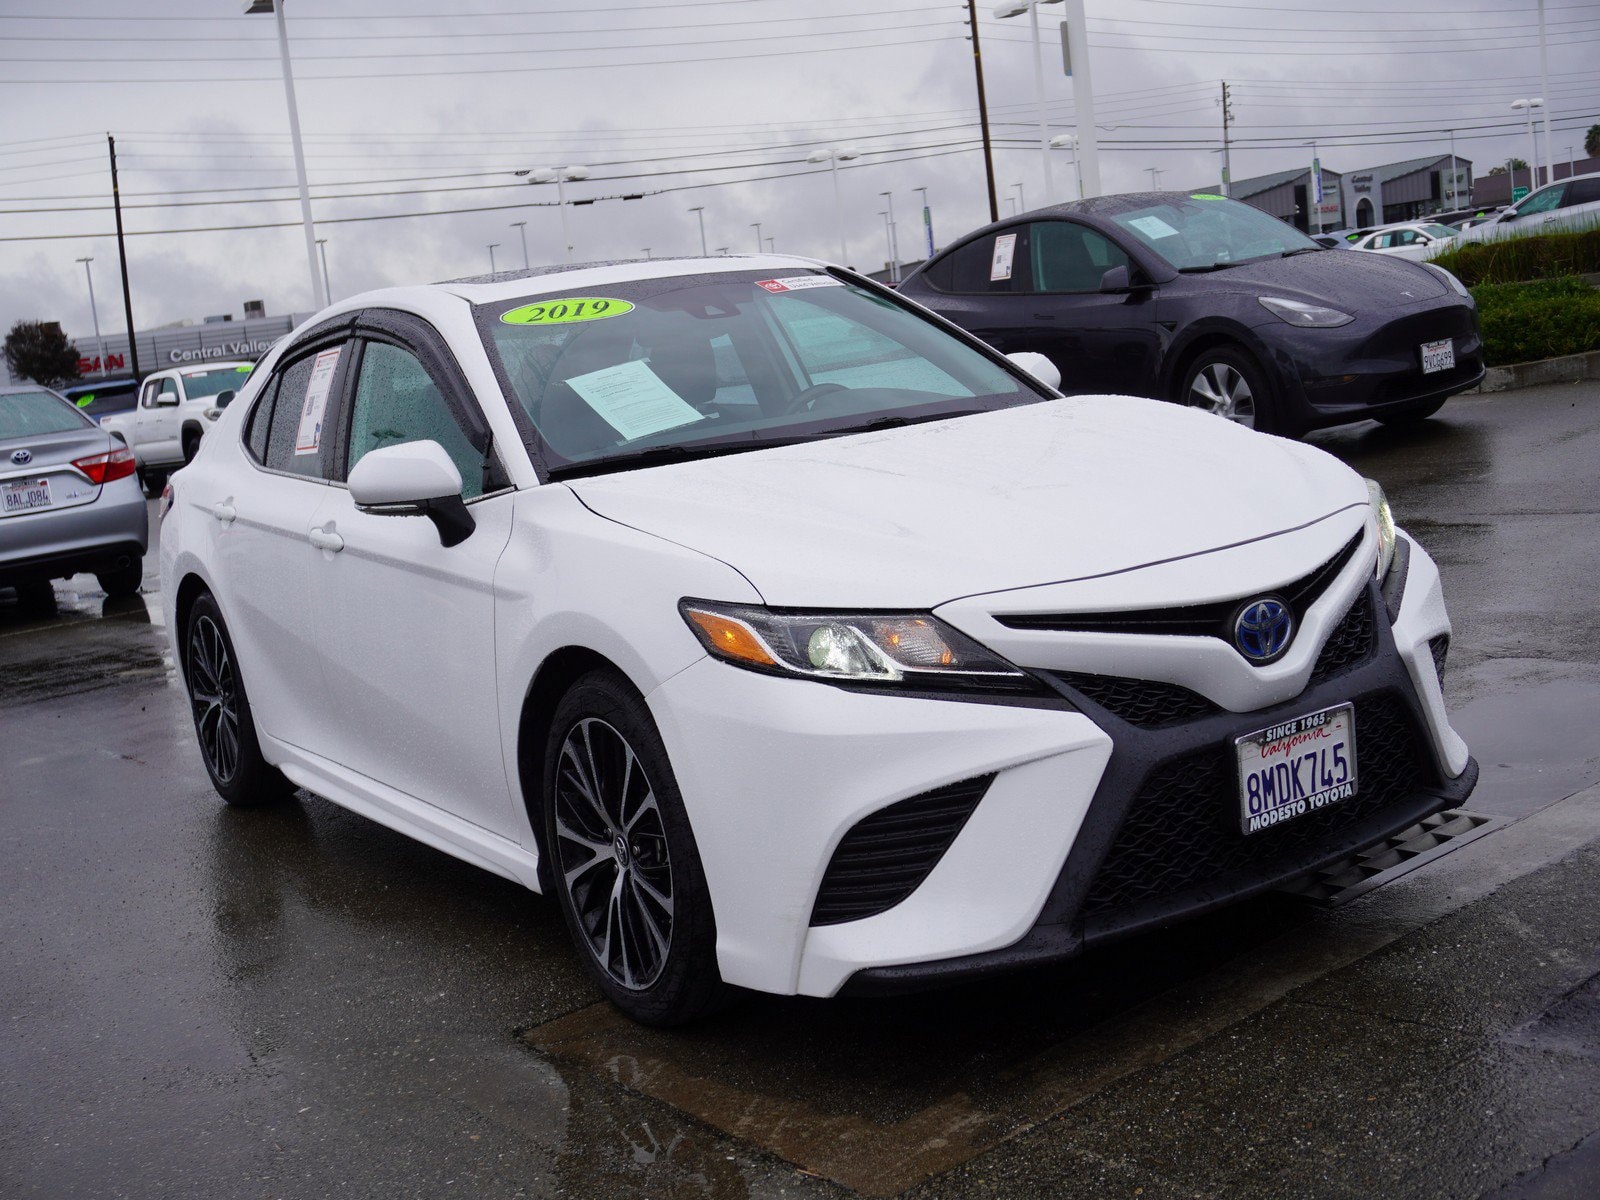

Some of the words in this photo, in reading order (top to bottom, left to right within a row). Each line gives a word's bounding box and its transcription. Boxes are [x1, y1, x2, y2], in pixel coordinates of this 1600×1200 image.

[526, 300, 610, 322] 2019
[169, 344, 226, 363] Central
[1266, 722, 1297, 742] SINCE
[1300, 712, 1326, 731] 1965
[1261, 727, 1331, 759] California
[1247, 742, 1348, 815] 8MDK745
[1250, 799, 1306, 832] MODESTO
[1308, 783, 1353, 811] TOYOTA
